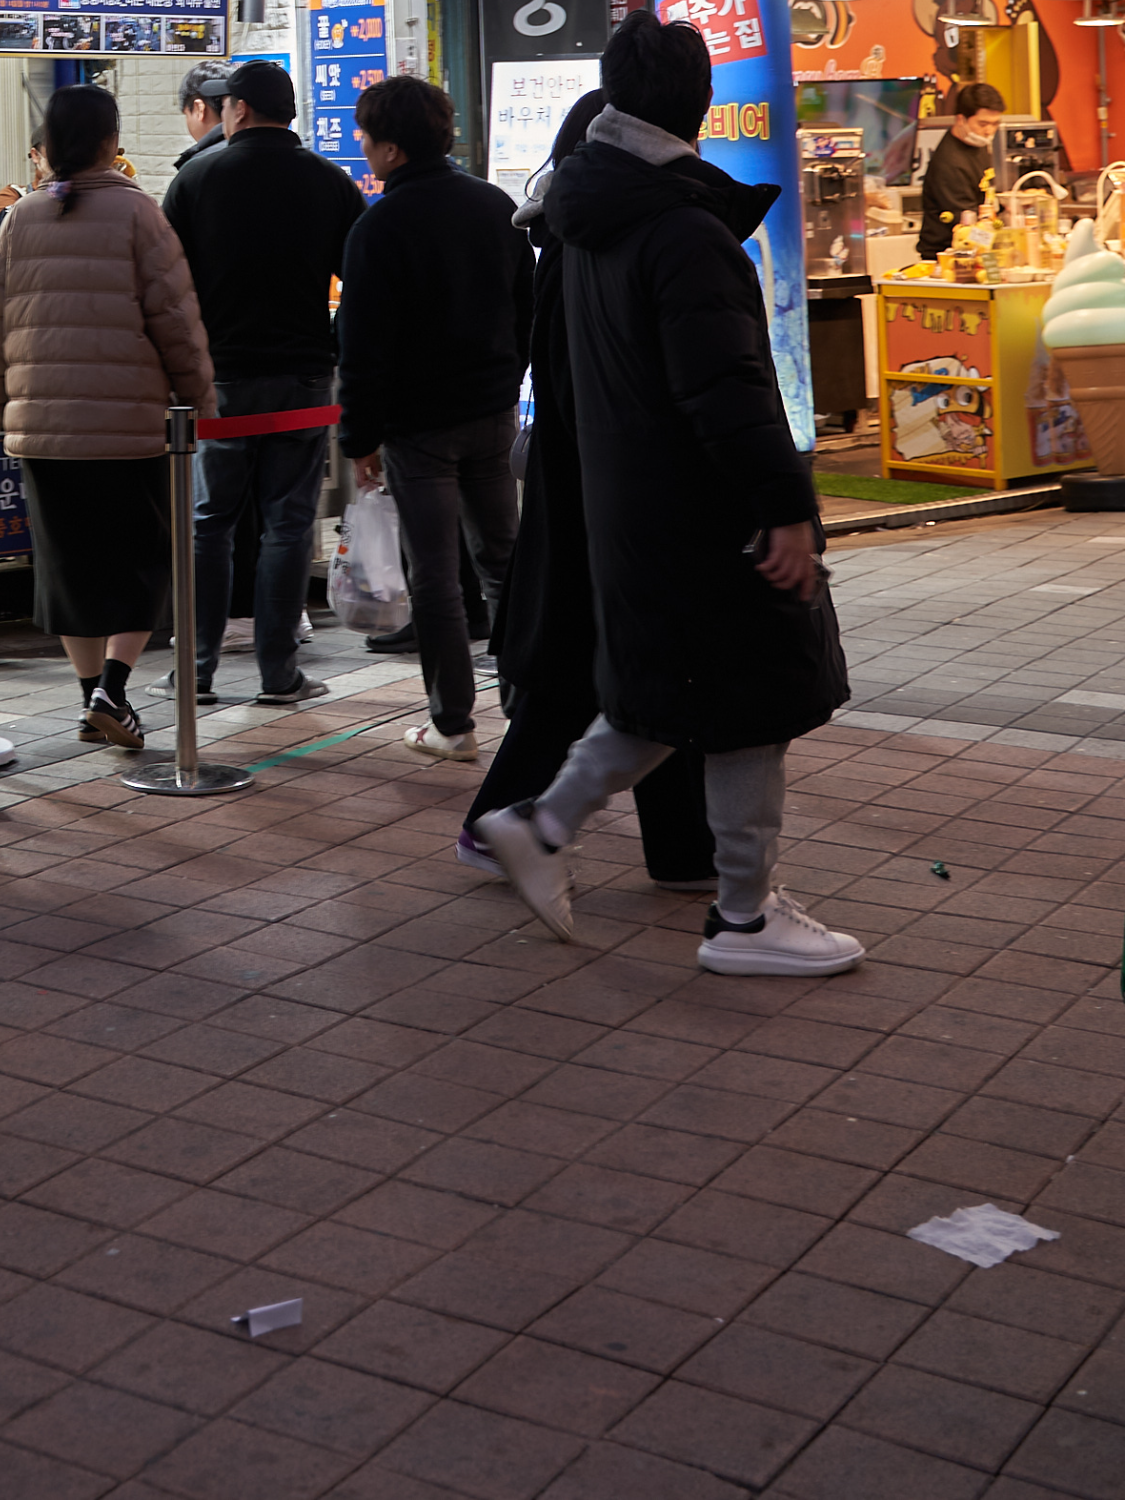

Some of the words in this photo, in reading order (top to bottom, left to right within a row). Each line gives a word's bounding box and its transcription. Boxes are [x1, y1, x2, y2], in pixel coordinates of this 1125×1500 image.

[733, 17, 763, 49] 집
[498, 105, 552, 129] 바우처
[698, 102, 770, 141] 비어
